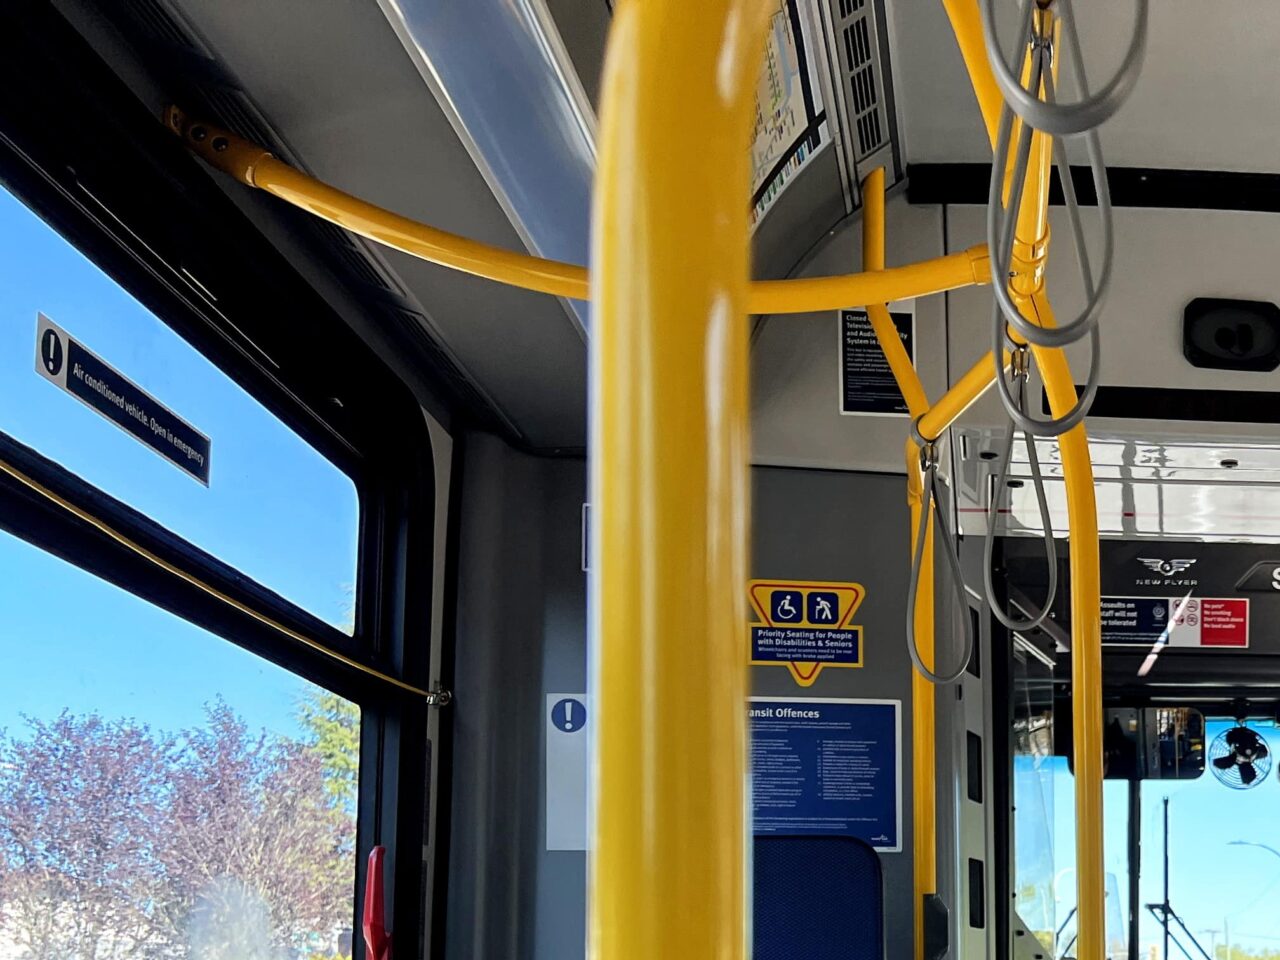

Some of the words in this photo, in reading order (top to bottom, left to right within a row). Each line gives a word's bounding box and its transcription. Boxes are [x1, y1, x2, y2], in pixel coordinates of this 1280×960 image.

[73, 363, 84, 380] Air
[84, 373, 124, 409] conditioned
[125, 401, 149, 427] vehicle.
[150, 418, 166, 438] Open
[167, 432, 173, 443] in
[174, 436, 204, 467] emergency
[758, 630, 785, 639] Priority
[787, 630, 814, 640] Seating
[828, 632, 852, 640] People
[747, 708, 773, 718] ansit
[776, 708, 820, 718] Offences
